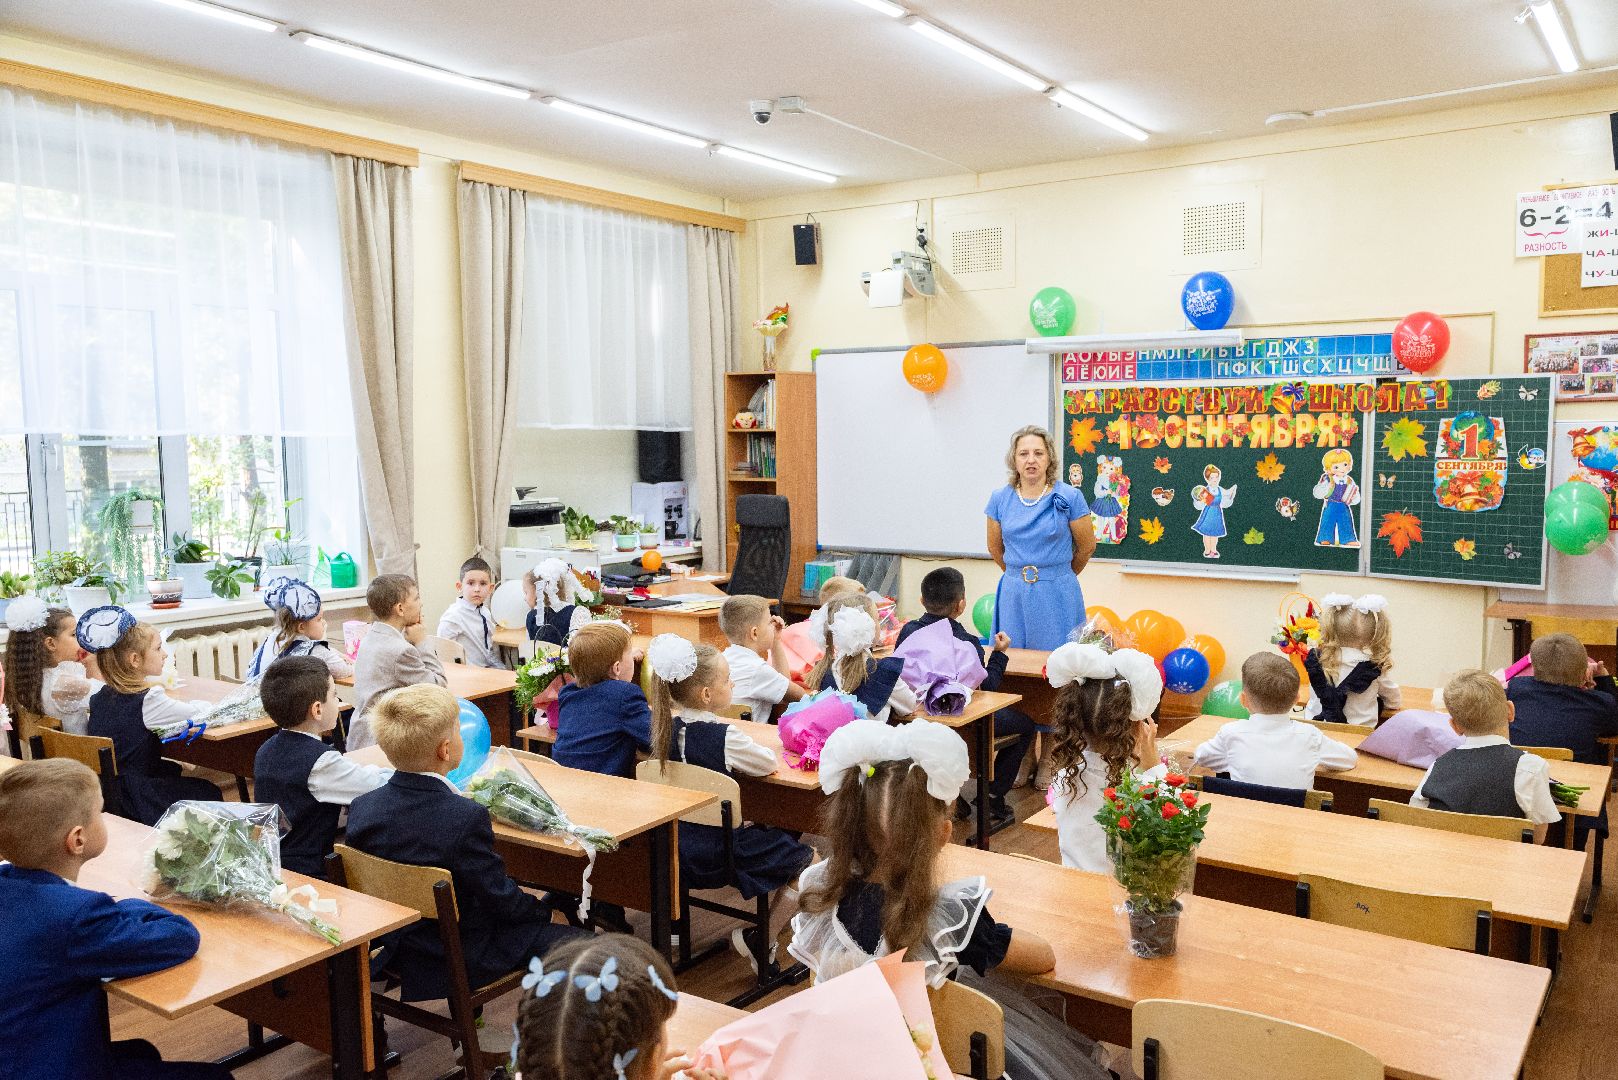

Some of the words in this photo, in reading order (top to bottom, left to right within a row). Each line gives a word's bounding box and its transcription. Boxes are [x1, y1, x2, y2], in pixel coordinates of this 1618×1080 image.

[1524, 241, 1568, 253] РАЗНОСТЬ
[1253, 342, 1262, 357] Г
[1267, 342, 1279, 358] Д
[1283, 340, 1299, 355] Ж
[1066, 366, 1074, 380] Я
[1094, 365, 1106, 380] Ю
[1125, 365, 1134, 379] Е
[1251, 361, 1262, 375] К
[1269, 361, 1280, 375] Т
[1283, 360, 1299, 375] Ш
[1320, 359, 1332, 374] Х
[1338, 358, 1351, 375] Ц
[1357, 358, 1369, 372] Ч
[1111, 414, 1132, 450] 1
[1459, 424, 1479, 459] 1
[1436, 461, 1508, 471] СЕНТЯБРЯ!
